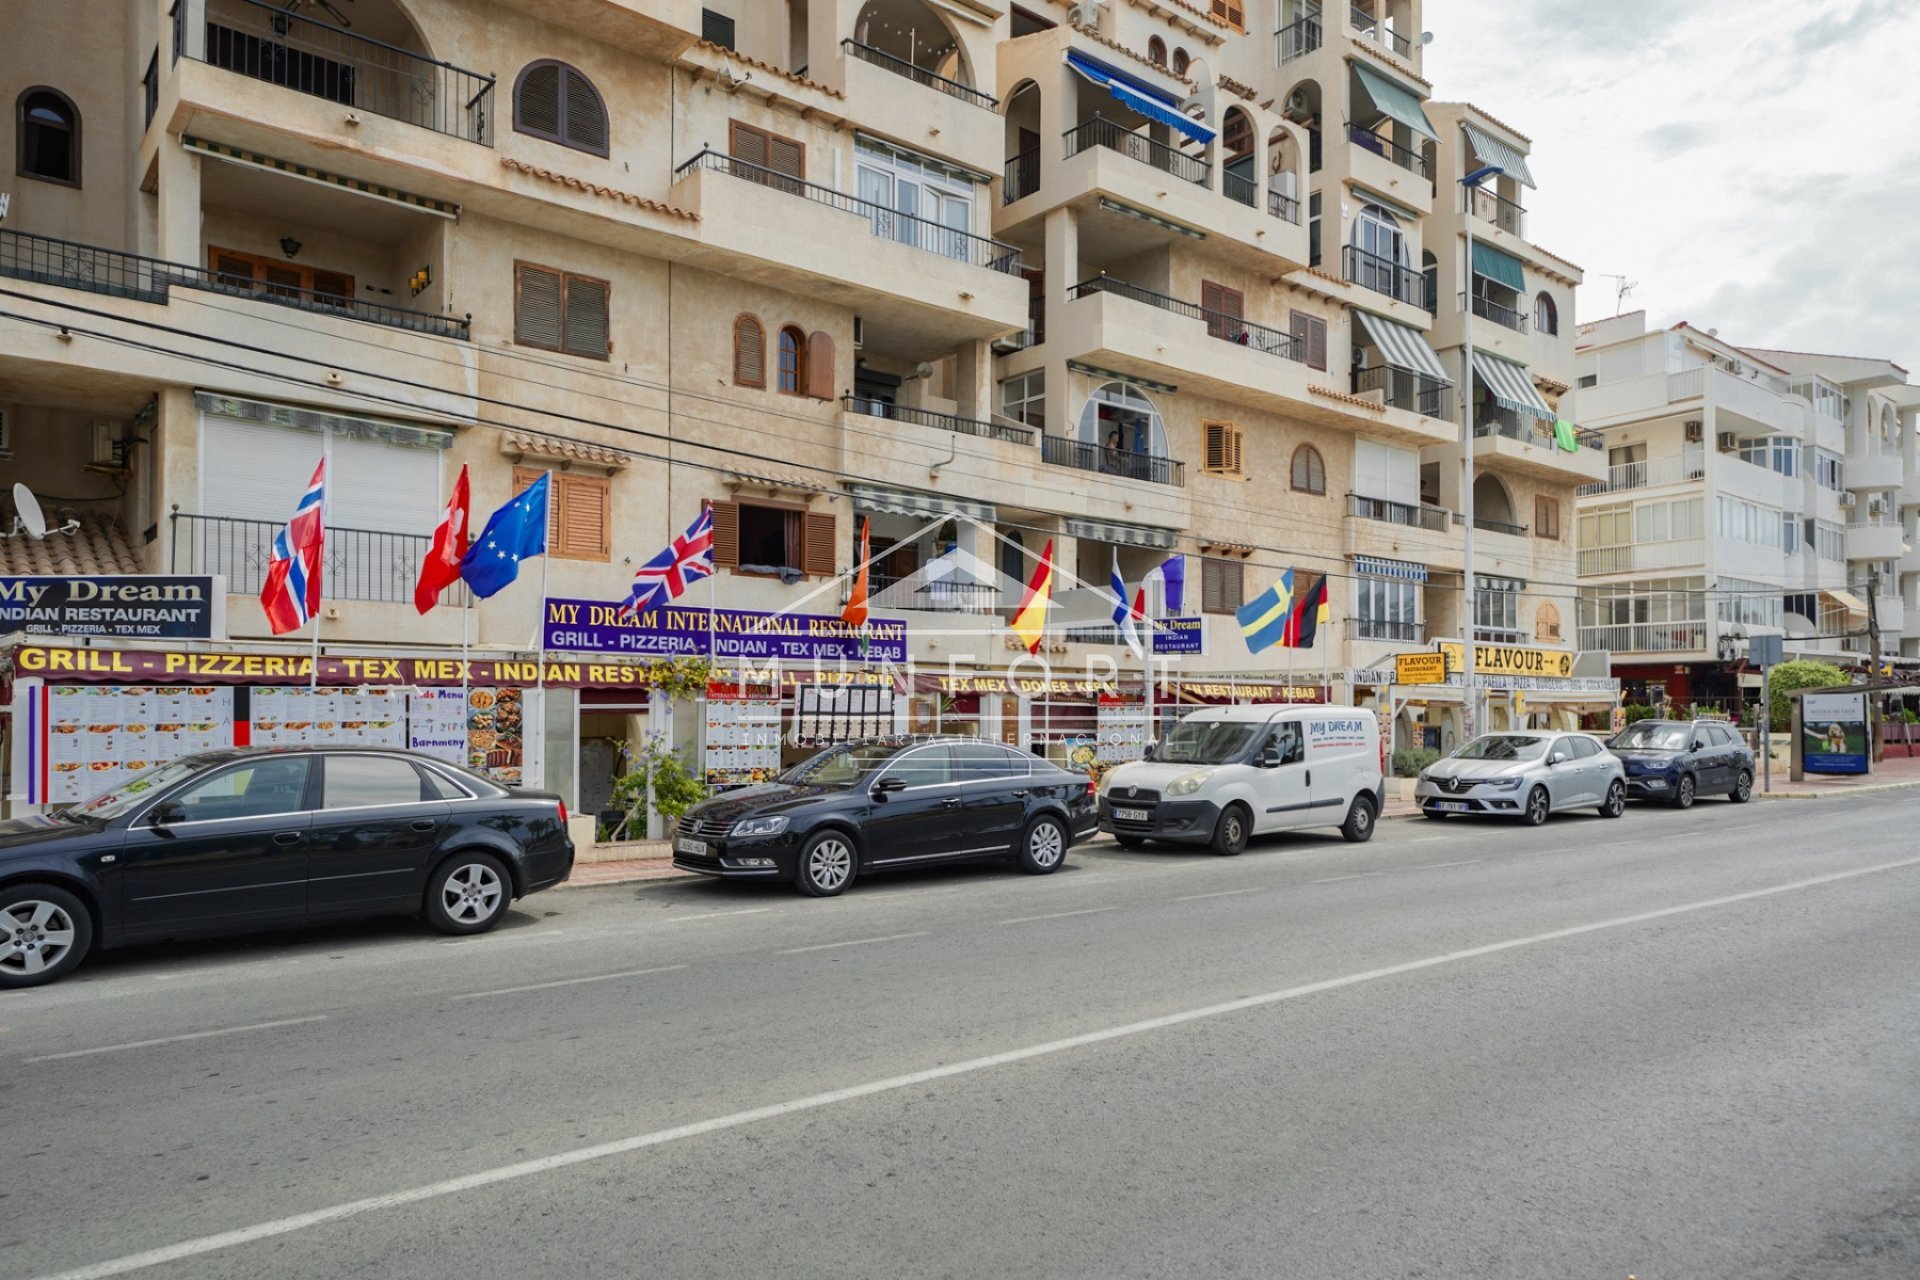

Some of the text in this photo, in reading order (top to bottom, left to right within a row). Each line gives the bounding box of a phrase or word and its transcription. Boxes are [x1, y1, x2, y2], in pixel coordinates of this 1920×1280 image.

[0, 580, 206, 607] My Dream
[65, 608, 201, 622] RESTAURANT
[549, 603, 581, 624] MY
[666, 611, 802, 634] INTERNATIONAL
[26, 624, 53, 633] GRILL
[61, 624, 106, 634] PIZZERIA
[115, 625, 134, 634] TEX
[137, 625, 160, 635] MEX
[1171, 621, 1200, 630] Dream
[551, 631, 603, 647] GRILL
[620, 635, 696, 652] PIZZERIA
[781, 642, 808, 655] TEX
[813, 644, 844, 657] MEX
[19, 648, 132, 672] GRILL
[166, 653, 318, 677] PIZZERIA
[342, 659, 400, 678] TEX
[414, 660, 473, 679] MEX
[1400, 656, 1441, 666] FLAVOUR
[1475, 647, 1543, 671] FLAVOUR
[939, 678, 969, 691] TEX
[973, 679, 1008, 692] MEX
[1354, 669, 1381, 683] INDIAN
[1483, 676, 1506, 689] PAELLA
[438, 690, 463, 699] Menu
[1204, 686, 1272, 698] RESTAURANT
[1283, 687, 1315, 698] KEBAB
[1328, 721, 1362, 732] DREAM
